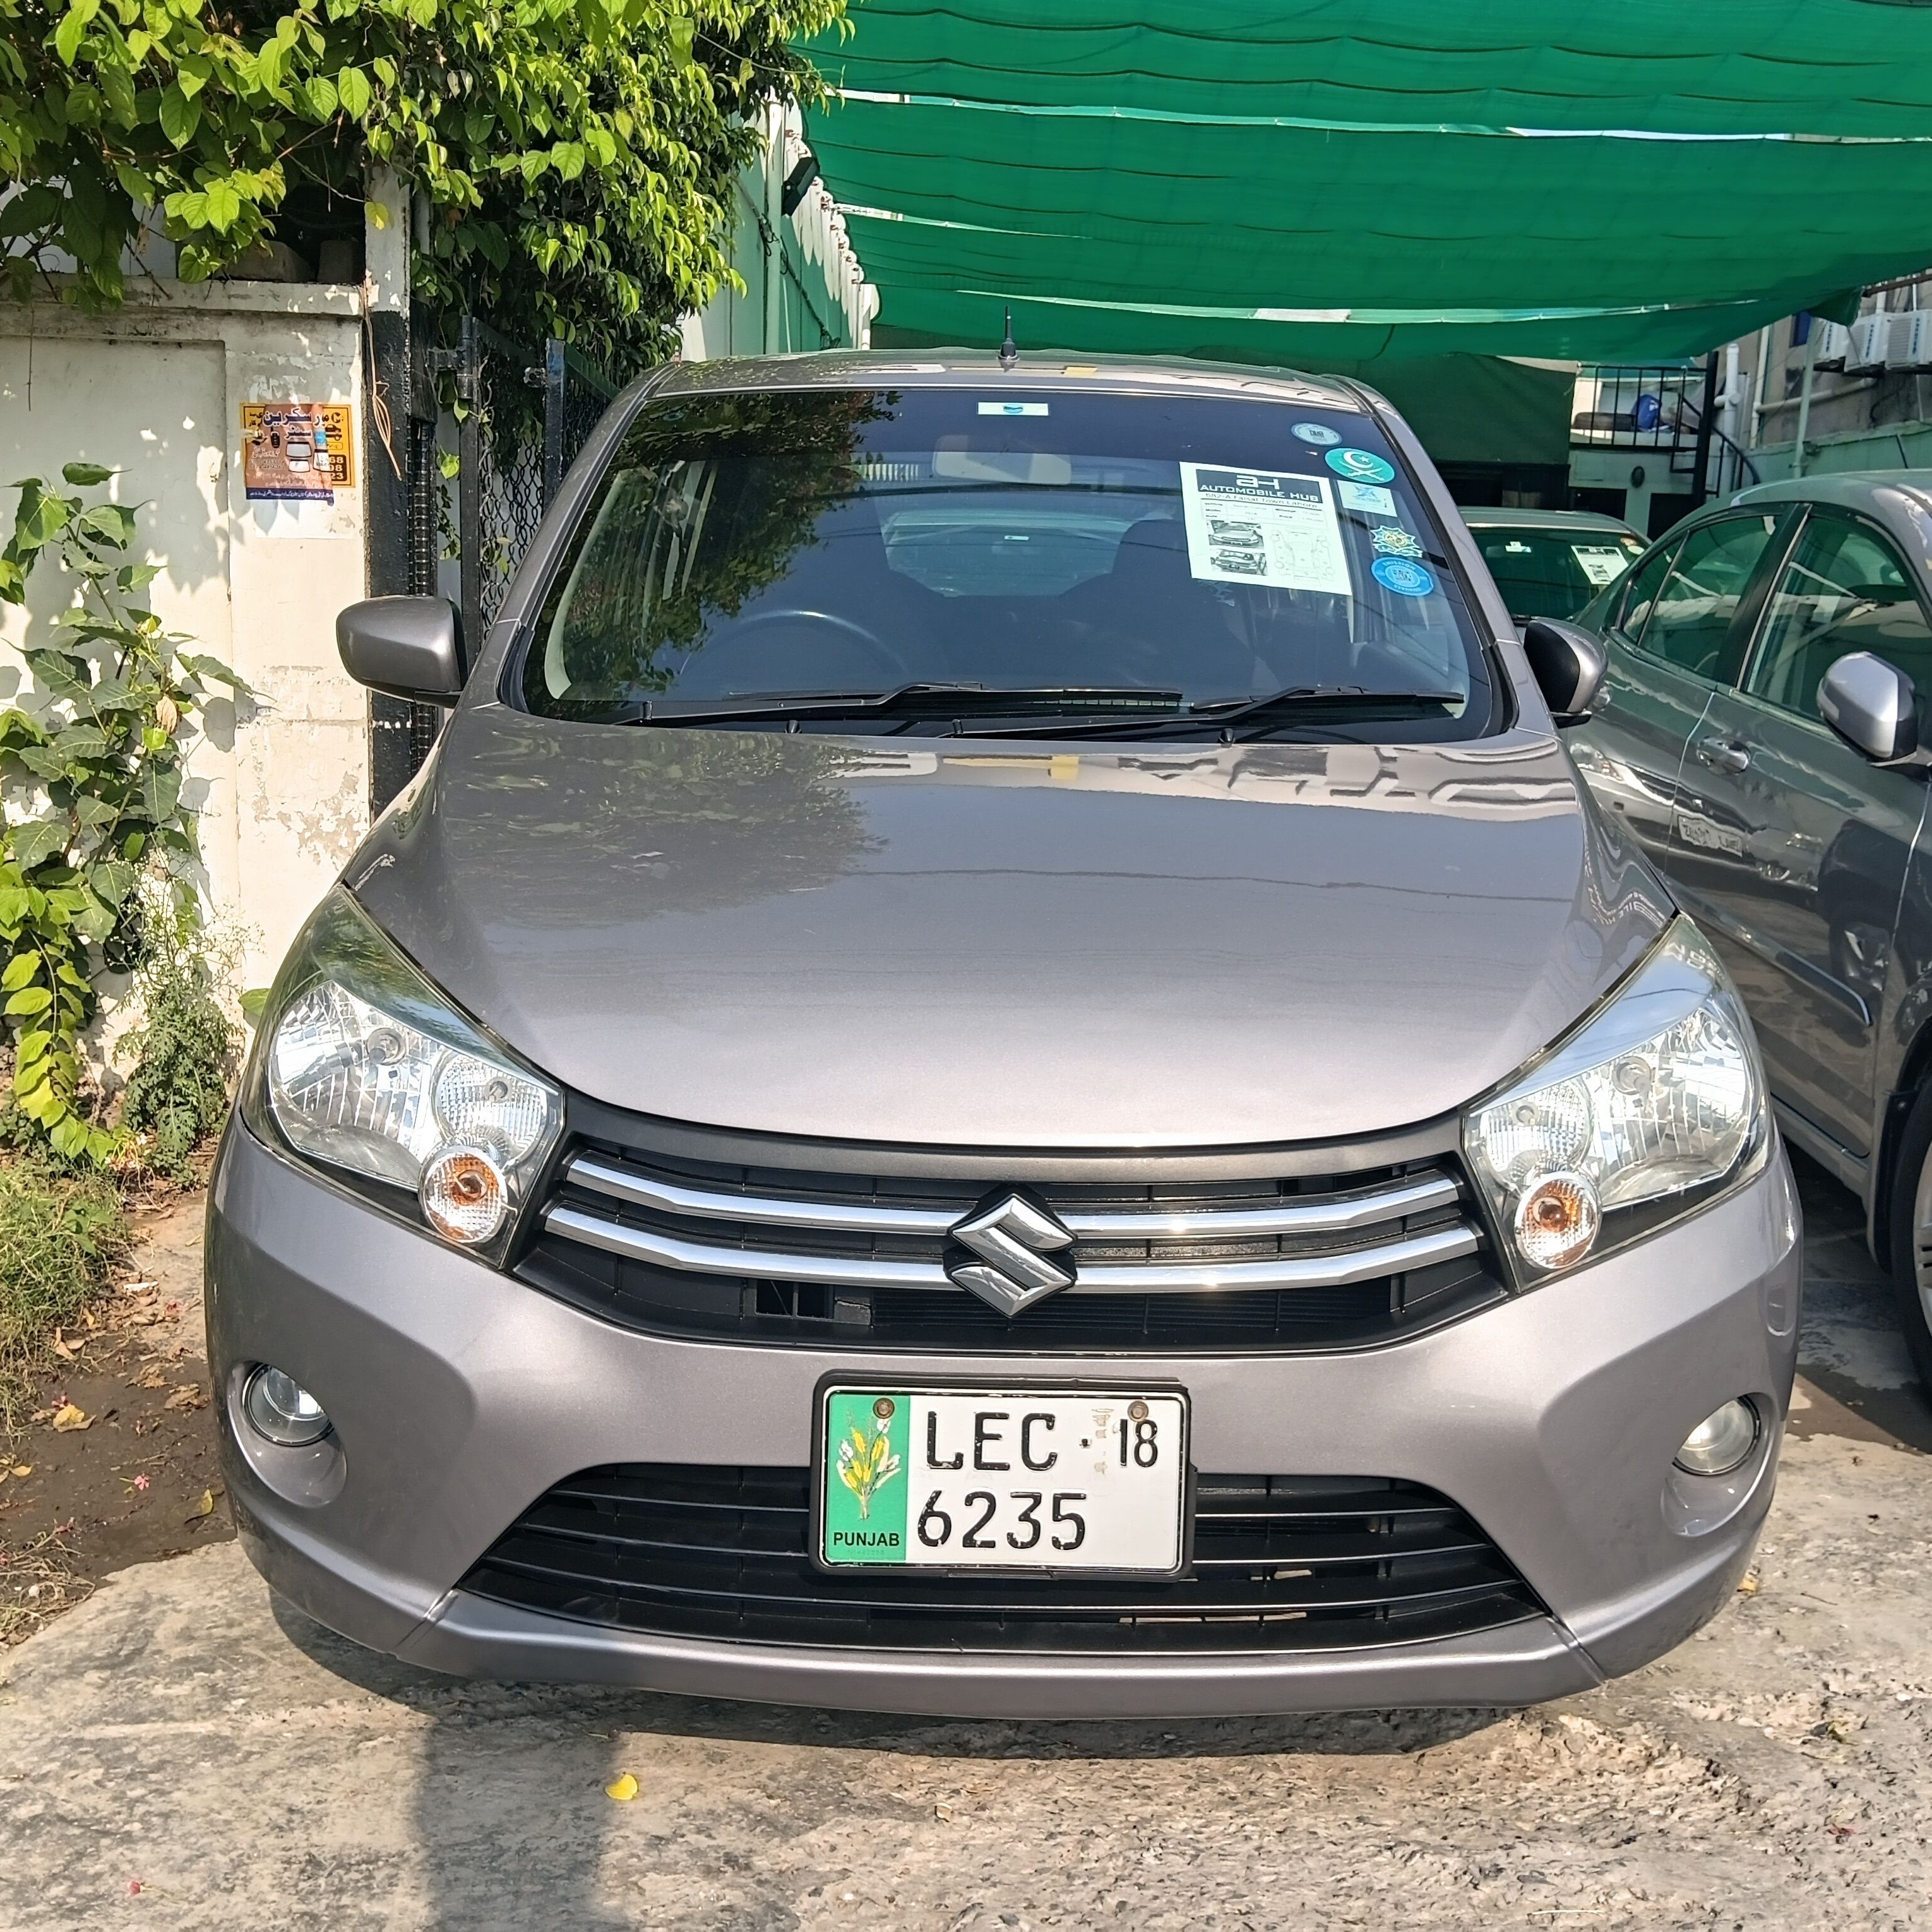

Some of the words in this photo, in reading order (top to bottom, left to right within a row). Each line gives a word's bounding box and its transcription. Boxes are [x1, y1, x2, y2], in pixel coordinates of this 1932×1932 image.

[1200, 484, 1286, 498] AUTOMOBILE
[1289, 492, 1319, 503] HUB
[1234, 494, 1258, 503] Faisal
[1286, 500, 1318, 508] Lahore
[926, 1410, 1058, 1472] LEC
[1119, 1419, 1159, 1468] 18
[917, 1489, 1087, 1550] 6235
[833, 1532, 900, 1547] PUNJAB
